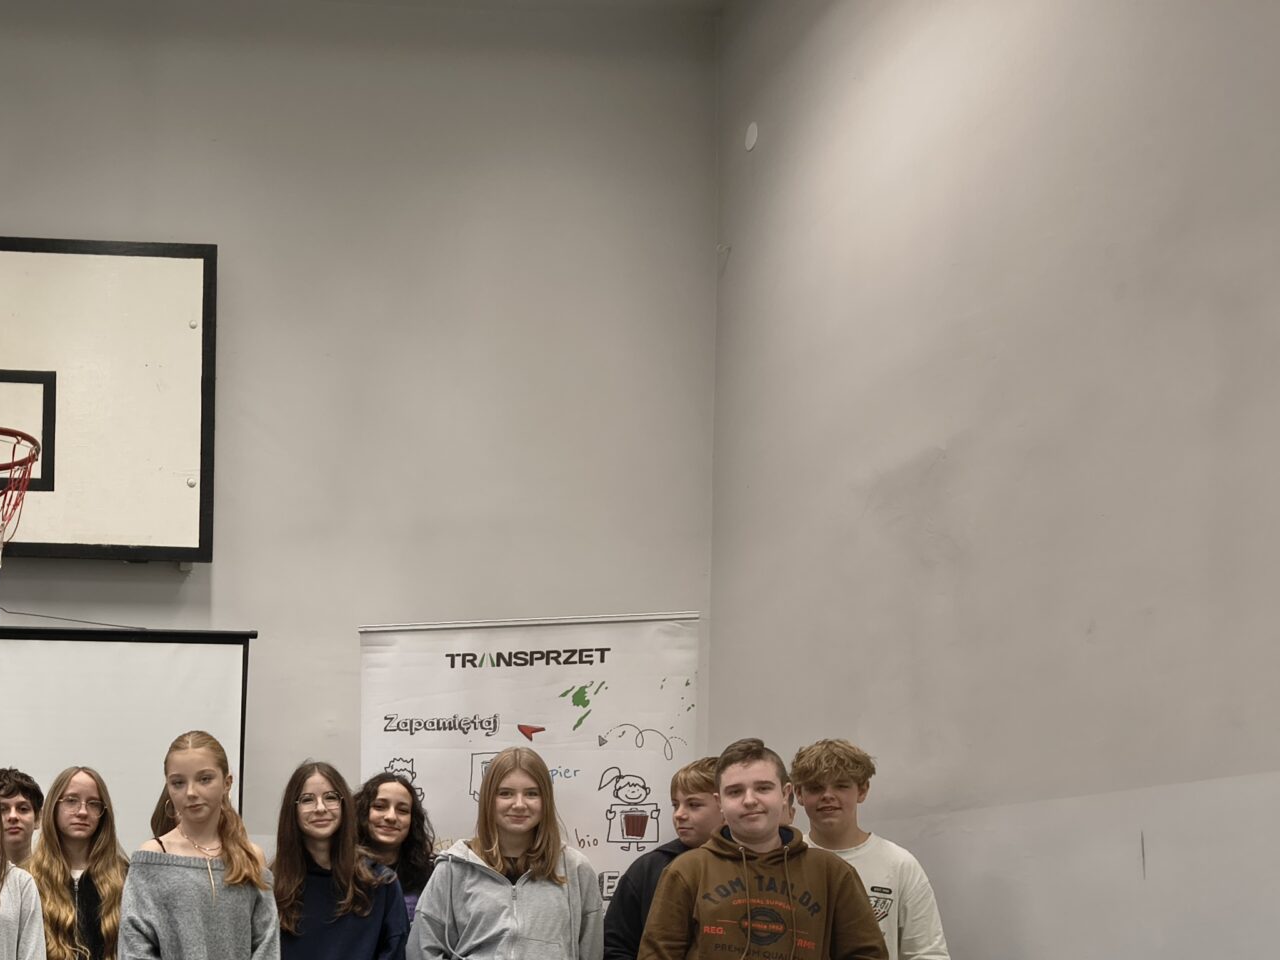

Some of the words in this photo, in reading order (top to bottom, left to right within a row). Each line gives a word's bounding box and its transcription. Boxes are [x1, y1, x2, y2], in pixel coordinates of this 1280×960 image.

[383, 713, 500, 736] Zapamiętaj
[549, 765, 580, 784] pier
[575, 828, 599, 848] bio
[702, 876, 747, 905] TOM
[754, 875, 821, 917] TAILOR
